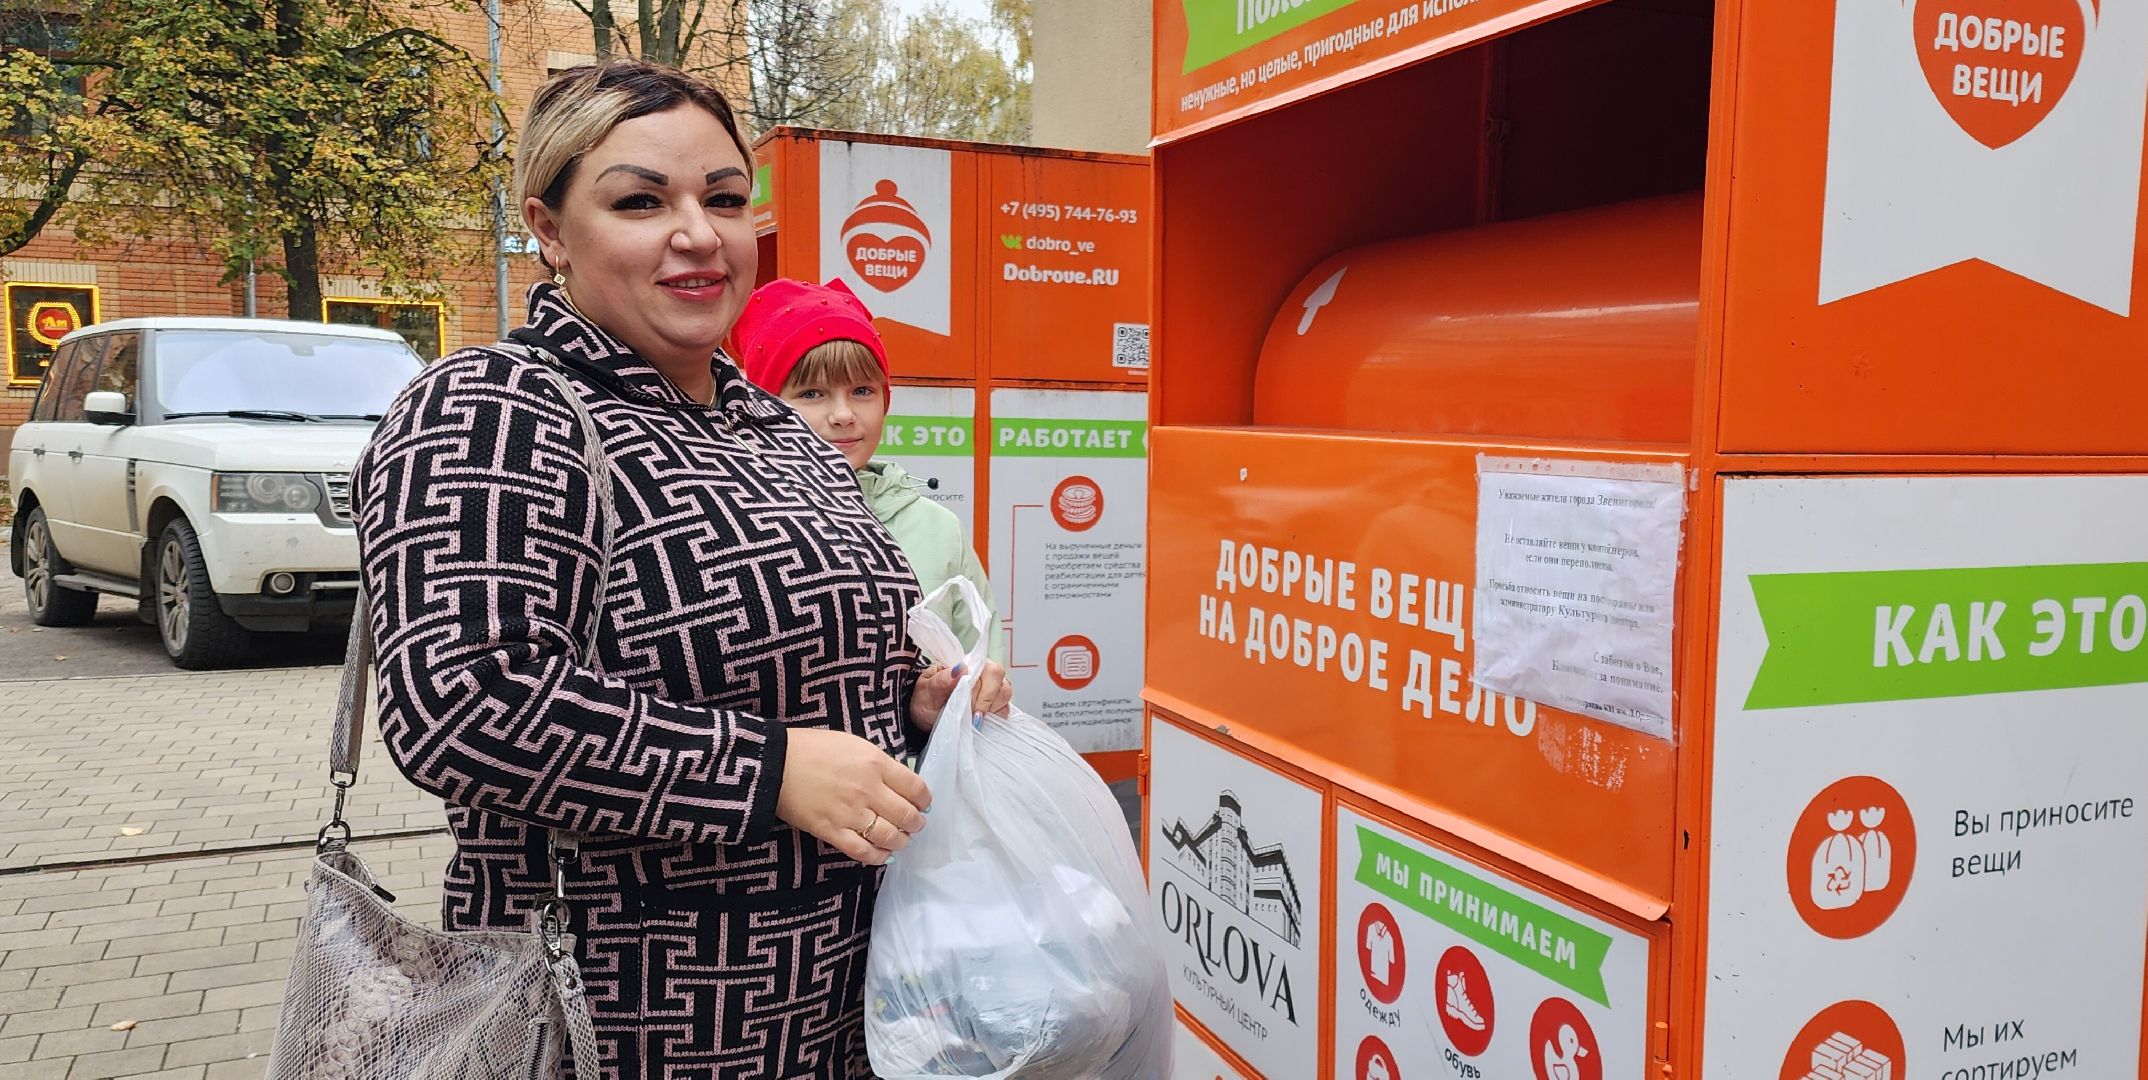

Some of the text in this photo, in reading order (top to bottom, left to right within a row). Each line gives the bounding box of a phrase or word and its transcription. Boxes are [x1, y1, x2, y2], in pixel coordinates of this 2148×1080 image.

[1934, 12, 2066, 58] ДОБРЫЕ
[1181, 73, 1240, 112] ненужные,
[1240, 70, 1255, 90] но
[1258, 49, 1302, 84] целые,
[1304, 17, 1384, 67] пригодные
[1386, 3, 1419, 38] для
[1952, 63, 2043, 107] ВЕЩИ
[1000, 201, 1137, 224] +7 (495) 744-76-93
[856, 247, 917, 262] ДОБРЫЕ
[1026, 236, 1095, 255] dobro_ve
[864, 263, 908, 279] ВЕЩИ
[1003, 263, 1120, 286] Dobrove.RU
[912, 425, 966, 446] ЭТО
[999, 427, 1132, 449] РАБОТАЕТ
[1570, 496, 1595, 508] города
[1216, 539, 1477, 652] ДОБРЫЕ ВЕЩ
[1873, 594, 2147, 667] КАК ЭТО
[1200, 594, 1537, 737] НА ДОБРОЕ ДЕЛО
[1954, 797, 2134, 838] Вы приносите
[1951, 849, 2022, 878] вещи
[1376, 852, 1576, 971] МЫ ПРИНИМАЕМ
[1161, 880, 1300, 1028] ORLOVA
[1182, 962, 1268, 1042] КУЛЬТУРНЫЙ ЦЕНТР
[1360, 988, 1401, 1028] одежду
[1943, 1019, 2024, 1052] Мы их
[1445, 1047, 1480, 1079] обувь
